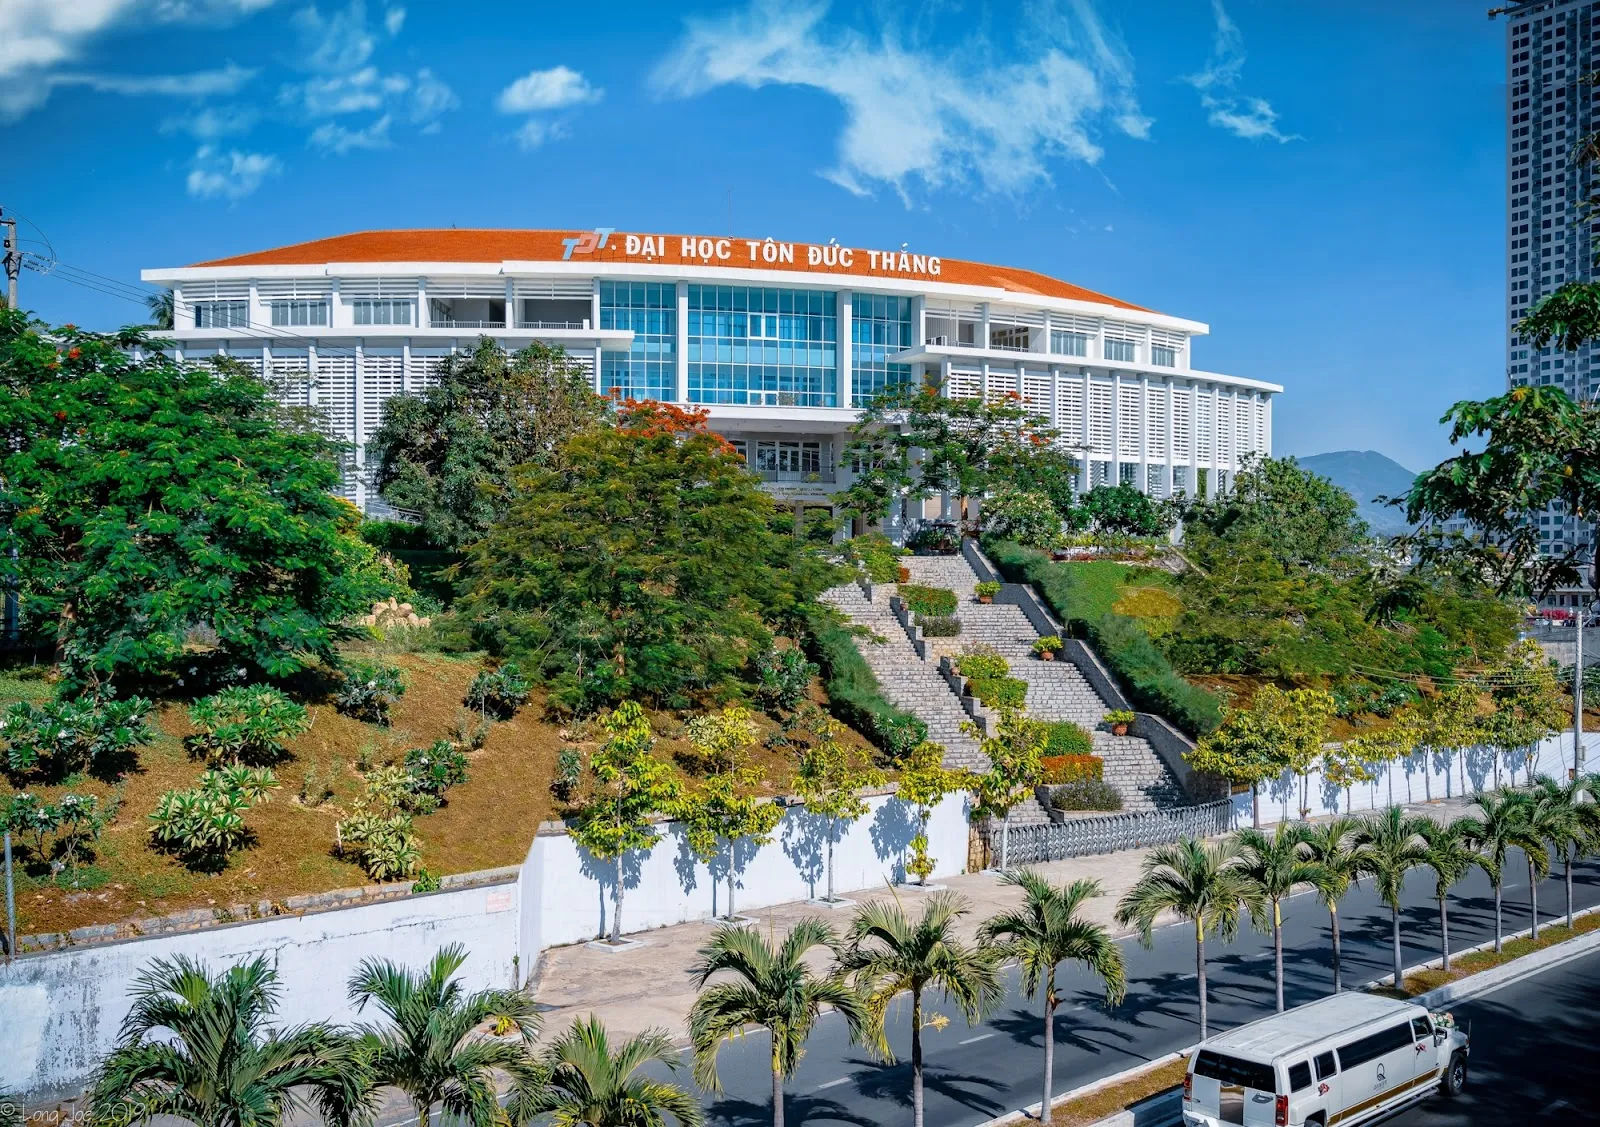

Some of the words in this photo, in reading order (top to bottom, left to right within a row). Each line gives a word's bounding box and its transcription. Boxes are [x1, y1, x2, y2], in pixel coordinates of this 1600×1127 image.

[625, 234, 665, 261] ĐẠI
[681, 237, 731, 263] HỌC
[746, 236, 794, 263] TÔN
[807, 237, 854, 267] ĐỨC
[867, 242, 941, 276] THẮNG
